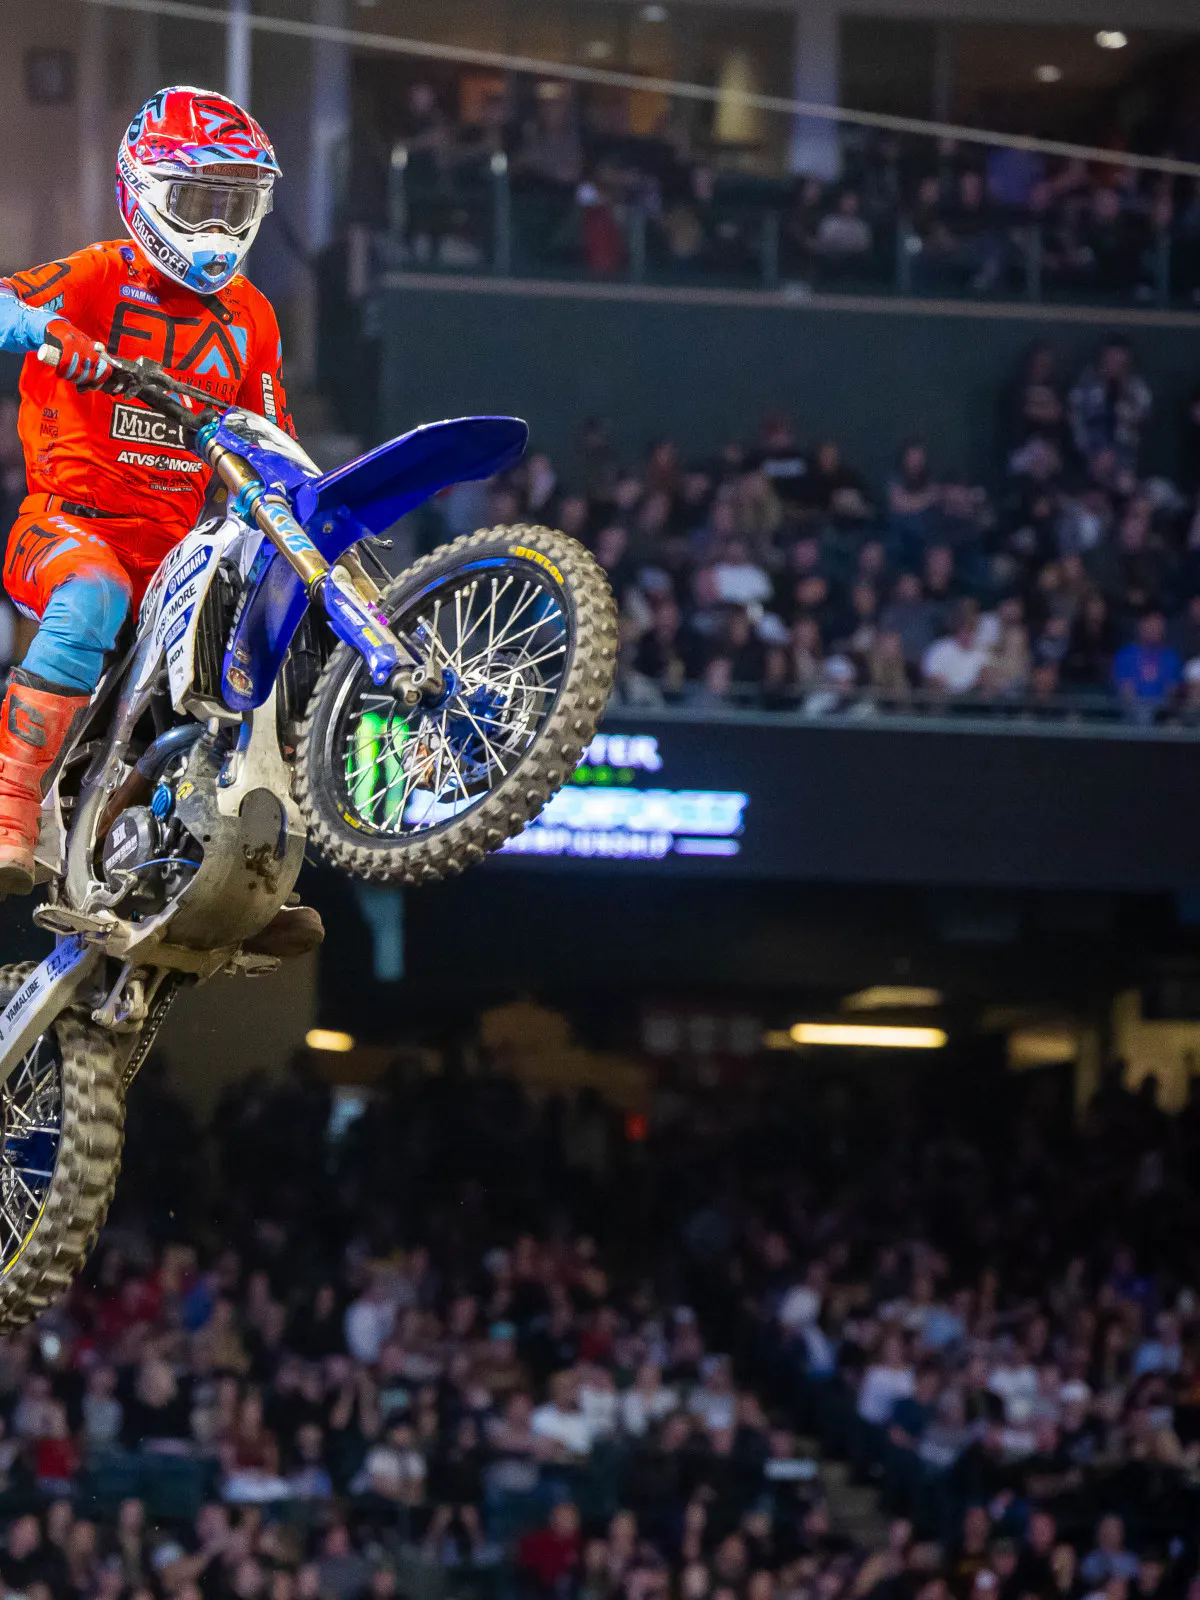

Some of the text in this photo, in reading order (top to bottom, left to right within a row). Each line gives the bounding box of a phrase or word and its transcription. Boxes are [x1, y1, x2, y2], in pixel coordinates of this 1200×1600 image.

[134, 214, 185, 277] Muc-Off
[119, 411, 184, 444] Muc-
[175, 549, 207, 586] YAMAHA
[5, 976, 44, 1022] YAMALUBE
